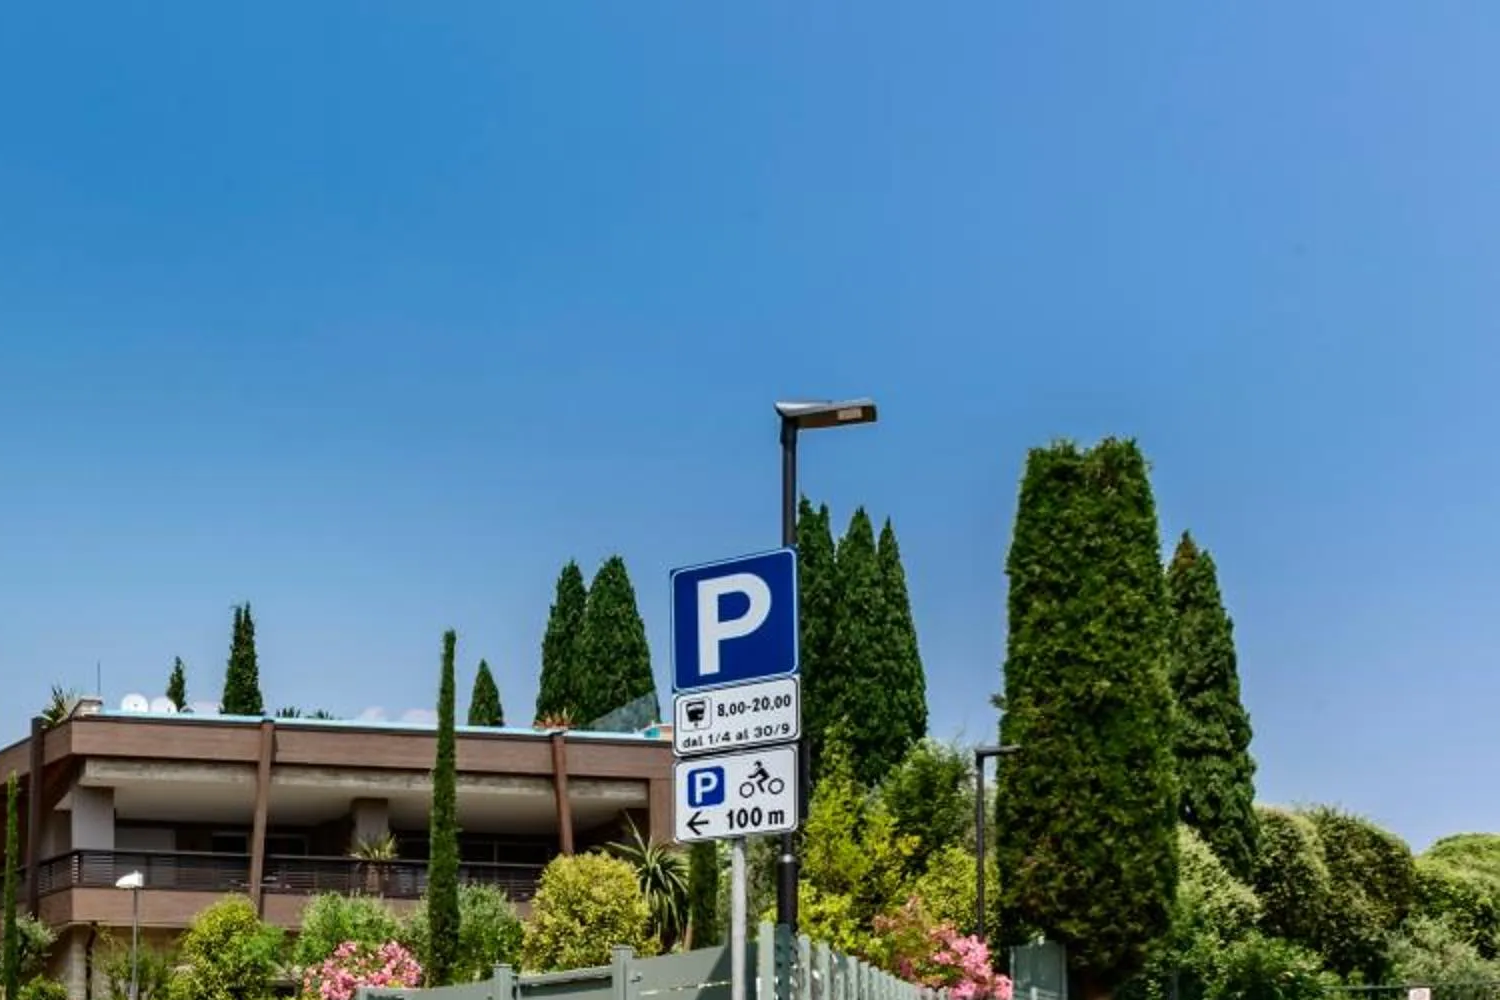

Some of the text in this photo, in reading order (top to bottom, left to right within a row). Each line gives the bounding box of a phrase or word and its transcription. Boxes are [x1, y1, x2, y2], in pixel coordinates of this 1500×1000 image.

[697, 573, 772, 676] P
[682, 723, 791, 749] dal 1/4 al 30/9
[694, 771, 718, 804] P
[726, 806, 785, 830] 100 m
